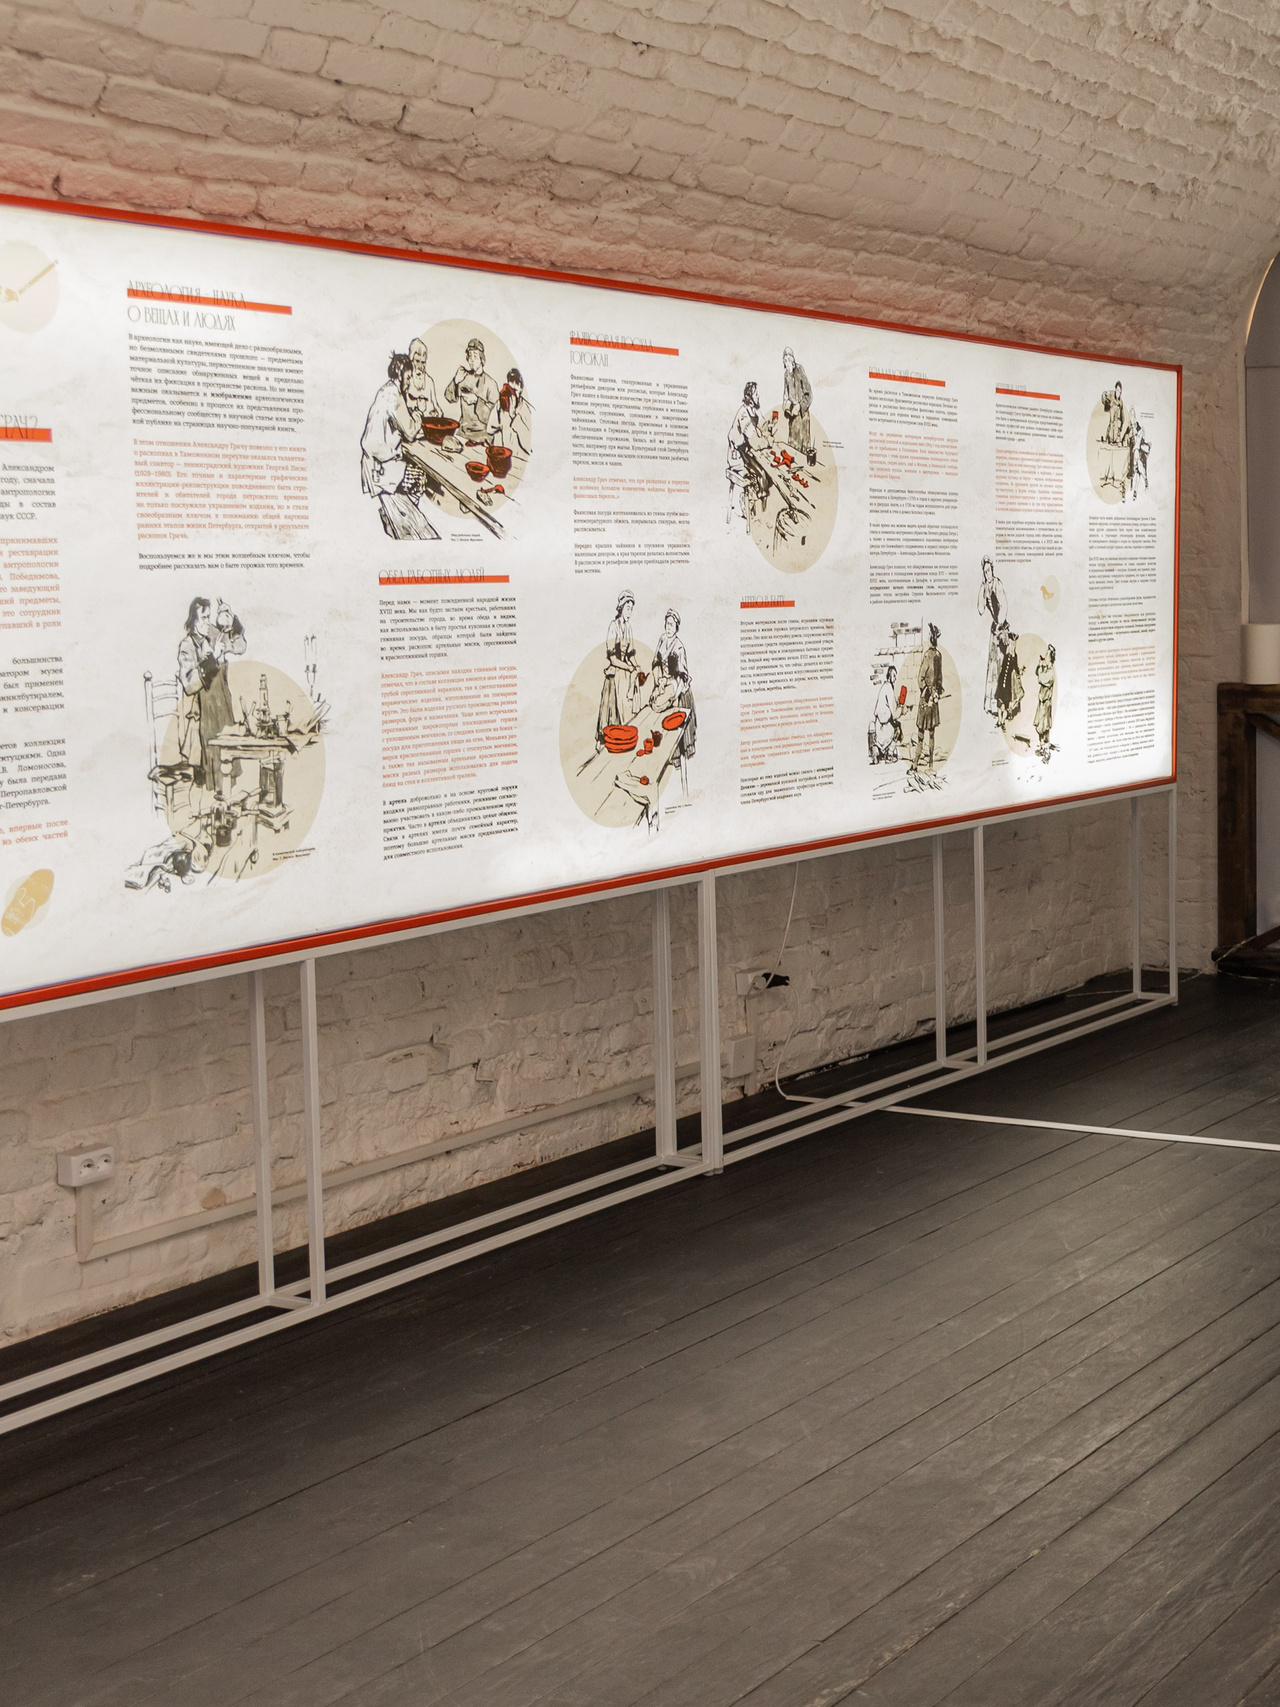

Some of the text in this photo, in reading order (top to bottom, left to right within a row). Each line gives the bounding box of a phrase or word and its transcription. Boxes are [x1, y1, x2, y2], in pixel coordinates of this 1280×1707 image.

[128, 280, 201, 303] АРХЕОЛОГИЯ
[213, 289, 247, 308] НАУКА
[128, 306, 235, 331] О ВЕЩАХ И ЛЮДЯХ
[570, 350, 608, 367] ГОРОЖАН
[0, 414, 38, 439] РАЧ?
[2, 464, 54, 473] Александром
[8, 550, 59, 558] реставрации
[3, 562, 59, 570] антропологии
[10, 584, 60, 594] заведующий
[20, 609, 61, 618] сотрудник
[42, 621, 61, 629] роли
[12, 656, 62, 665] большинства
[24, 680, 64, 690] применен
[14, 703, 64, 714] консервации
[24, 738, 66, 748] коллекция
[47, 748, 66, 758] Одна
[7, 776, 27, 785] была
[31, 773, 66, 784] передана
[9, 822, 42, 835] впервые
[46, 819, 68, 828] после
[15, 834, 38, 844] обеих
[42, 830, 68, 841] частей
